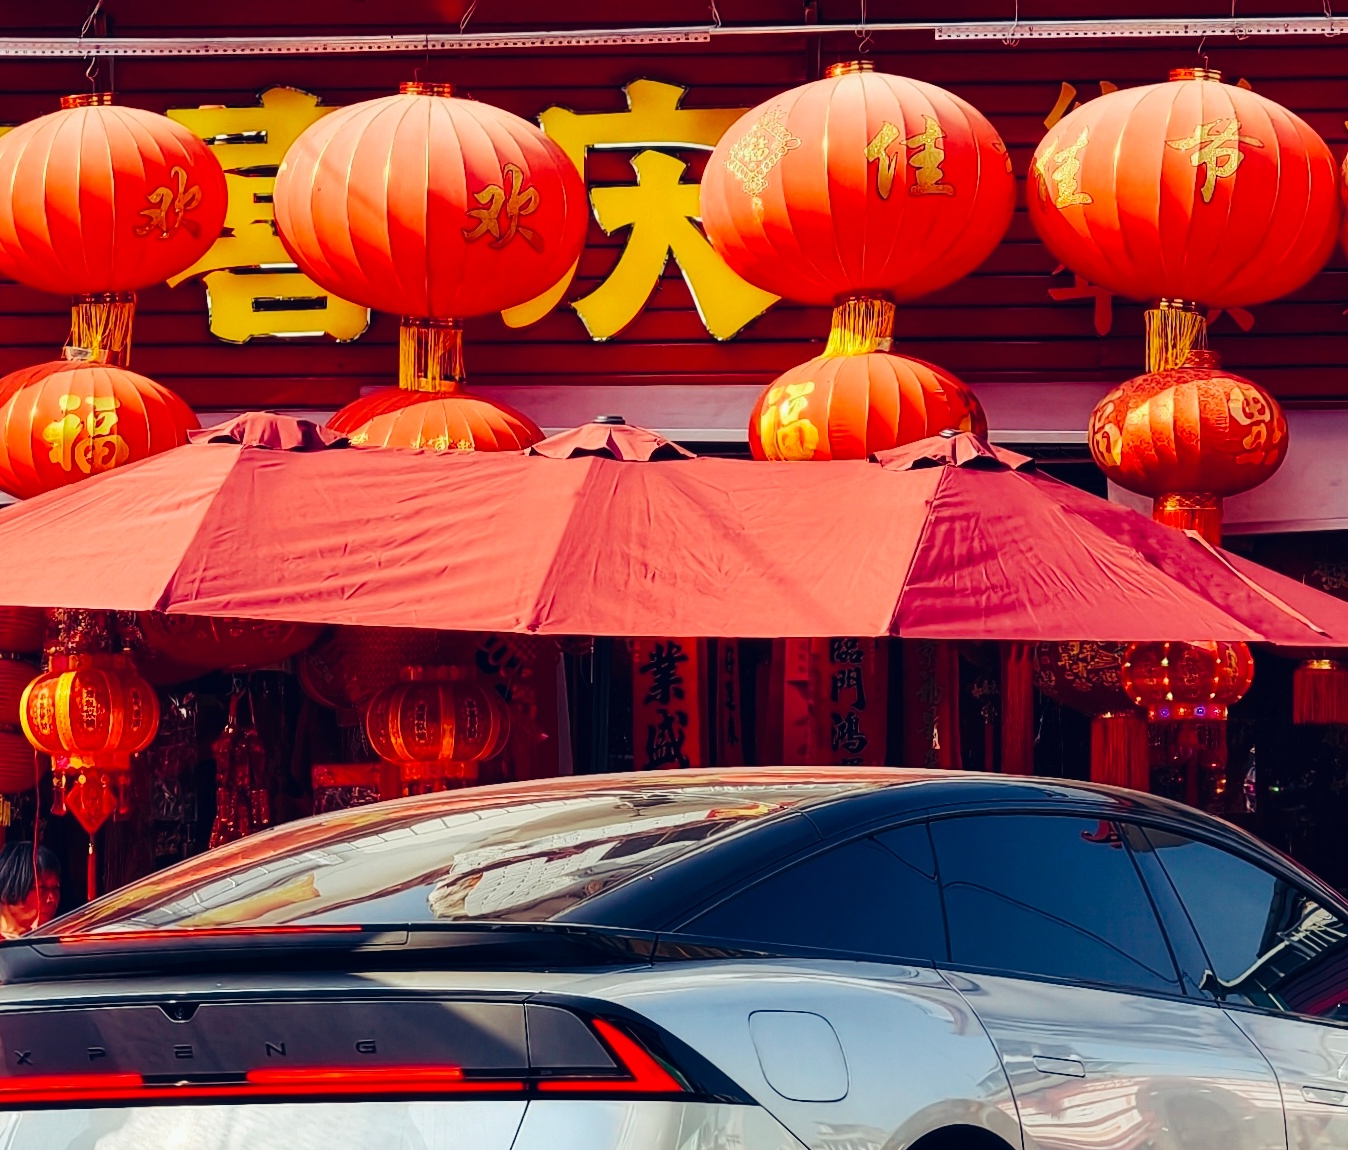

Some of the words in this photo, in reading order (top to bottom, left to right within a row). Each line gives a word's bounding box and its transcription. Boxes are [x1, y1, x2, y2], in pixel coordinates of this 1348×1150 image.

[863, 114, 955, 199] 佳
[135, 165, 202, 240] 欢
[463, 162, 545, 253] 欢
[43, 394, 130, 474] 福
[758, 380, 819, 461] 福
[829, 638, 869, 766] 臨門鴻
[14, 1037, 378, 1067] XPENG
